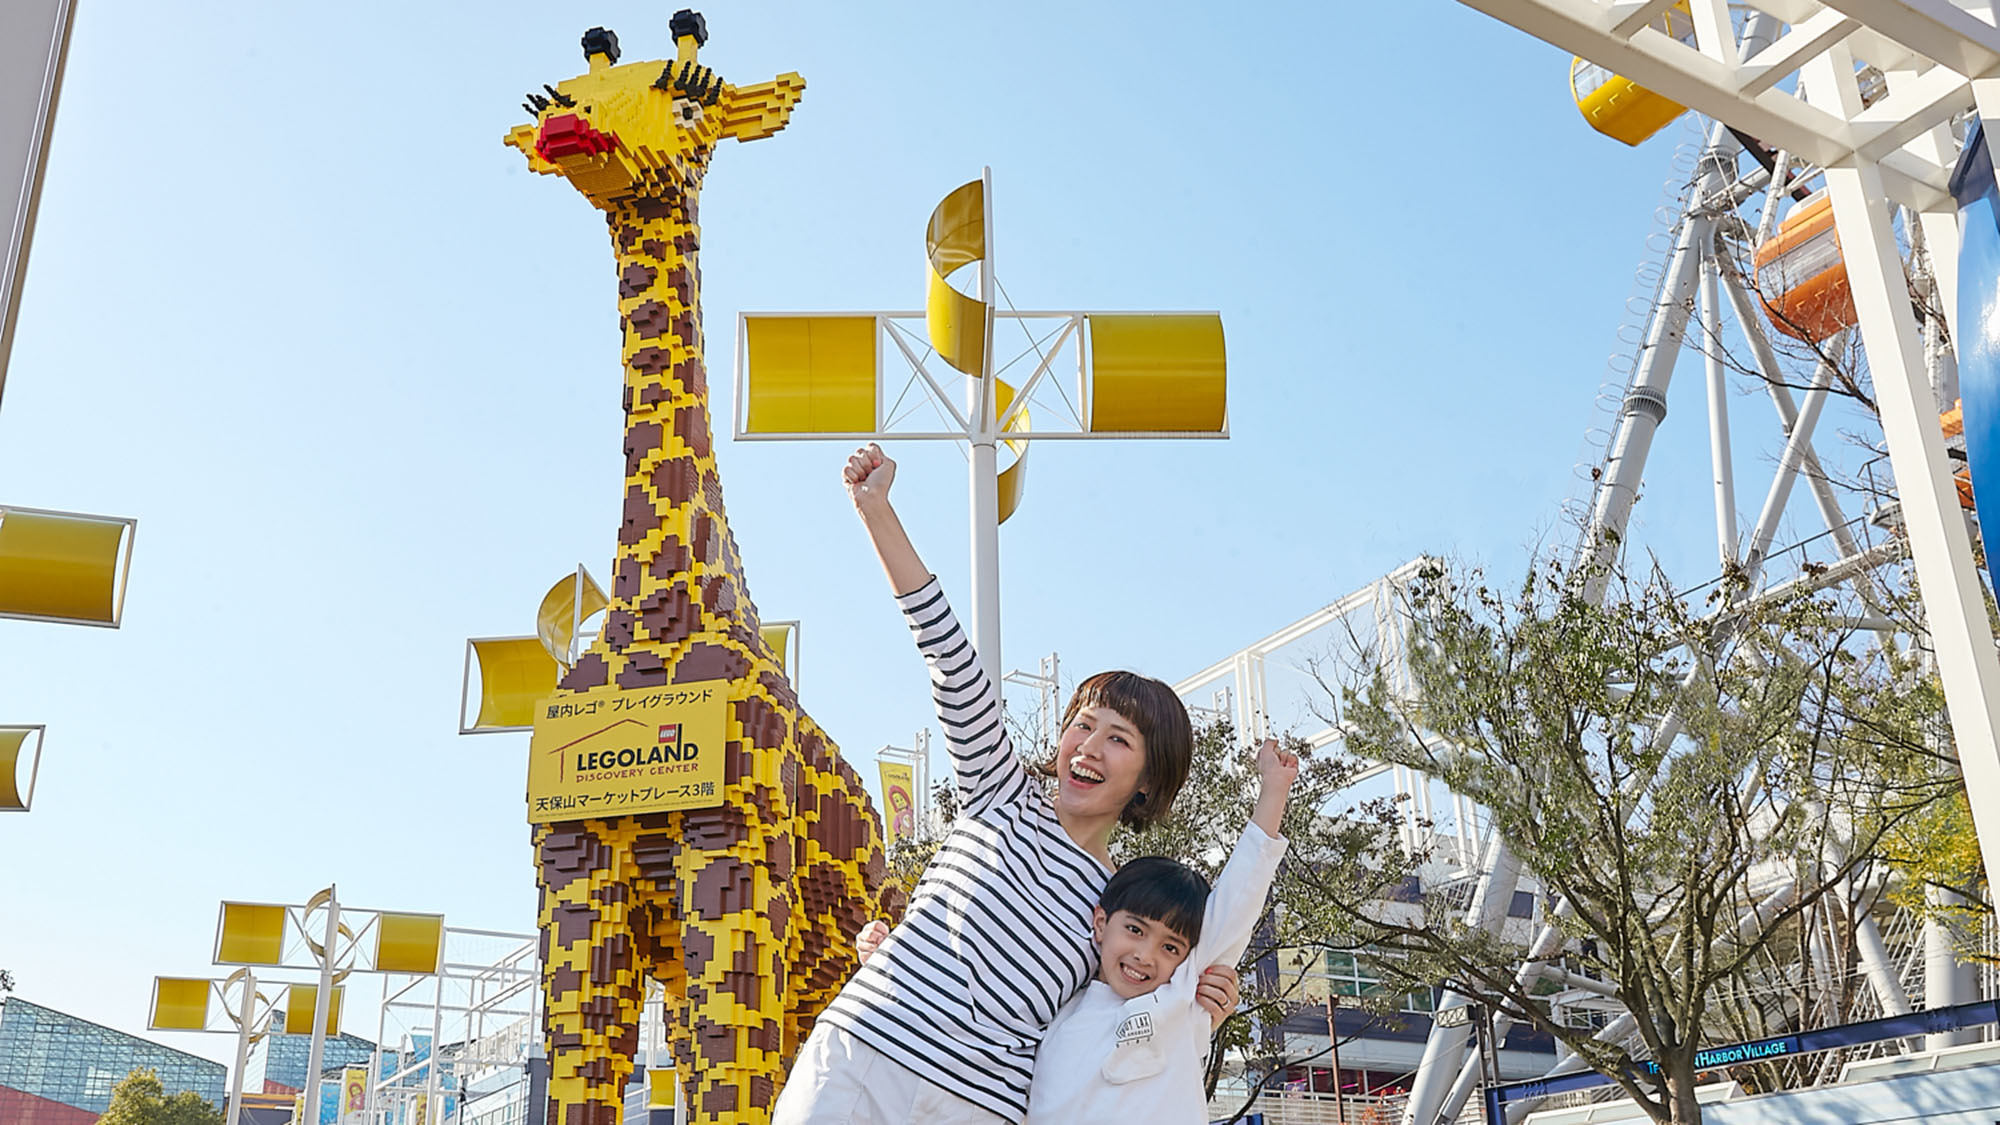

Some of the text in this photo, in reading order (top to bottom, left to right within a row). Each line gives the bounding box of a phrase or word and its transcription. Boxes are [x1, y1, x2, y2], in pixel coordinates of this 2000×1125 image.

[577, 723, 698, 771] LEGOLAND
[576, 762, 699, 783] DISCOVERY CENTER
[535, 781, 715, 811] 天保山マーケットプレース3階
